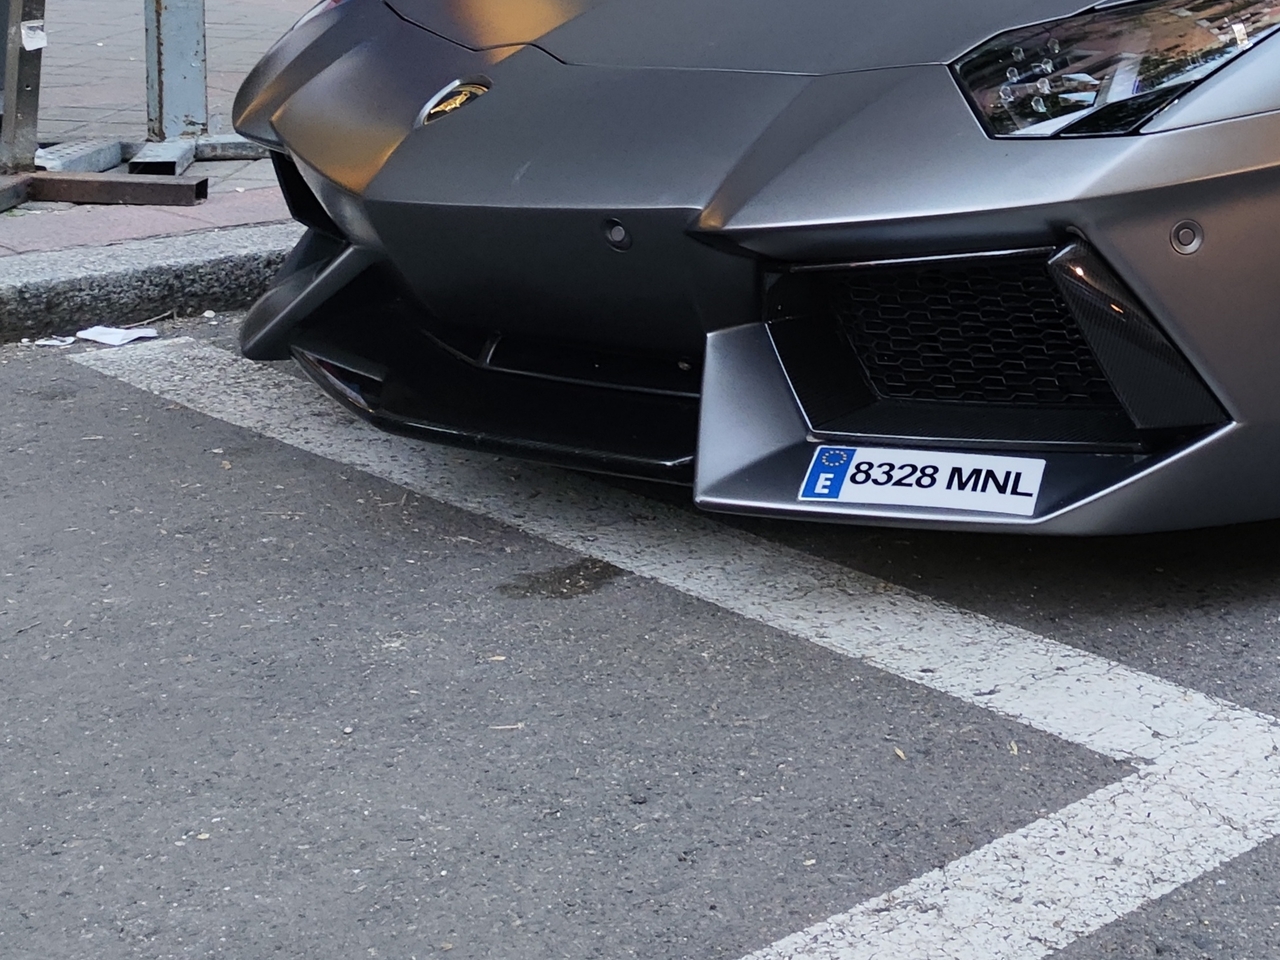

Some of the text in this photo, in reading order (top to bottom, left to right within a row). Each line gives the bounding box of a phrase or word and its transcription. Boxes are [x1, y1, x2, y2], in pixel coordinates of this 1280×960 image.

[814, 473, 834, 494] E
[849, 461, 1034, 498] 8328 MNL
